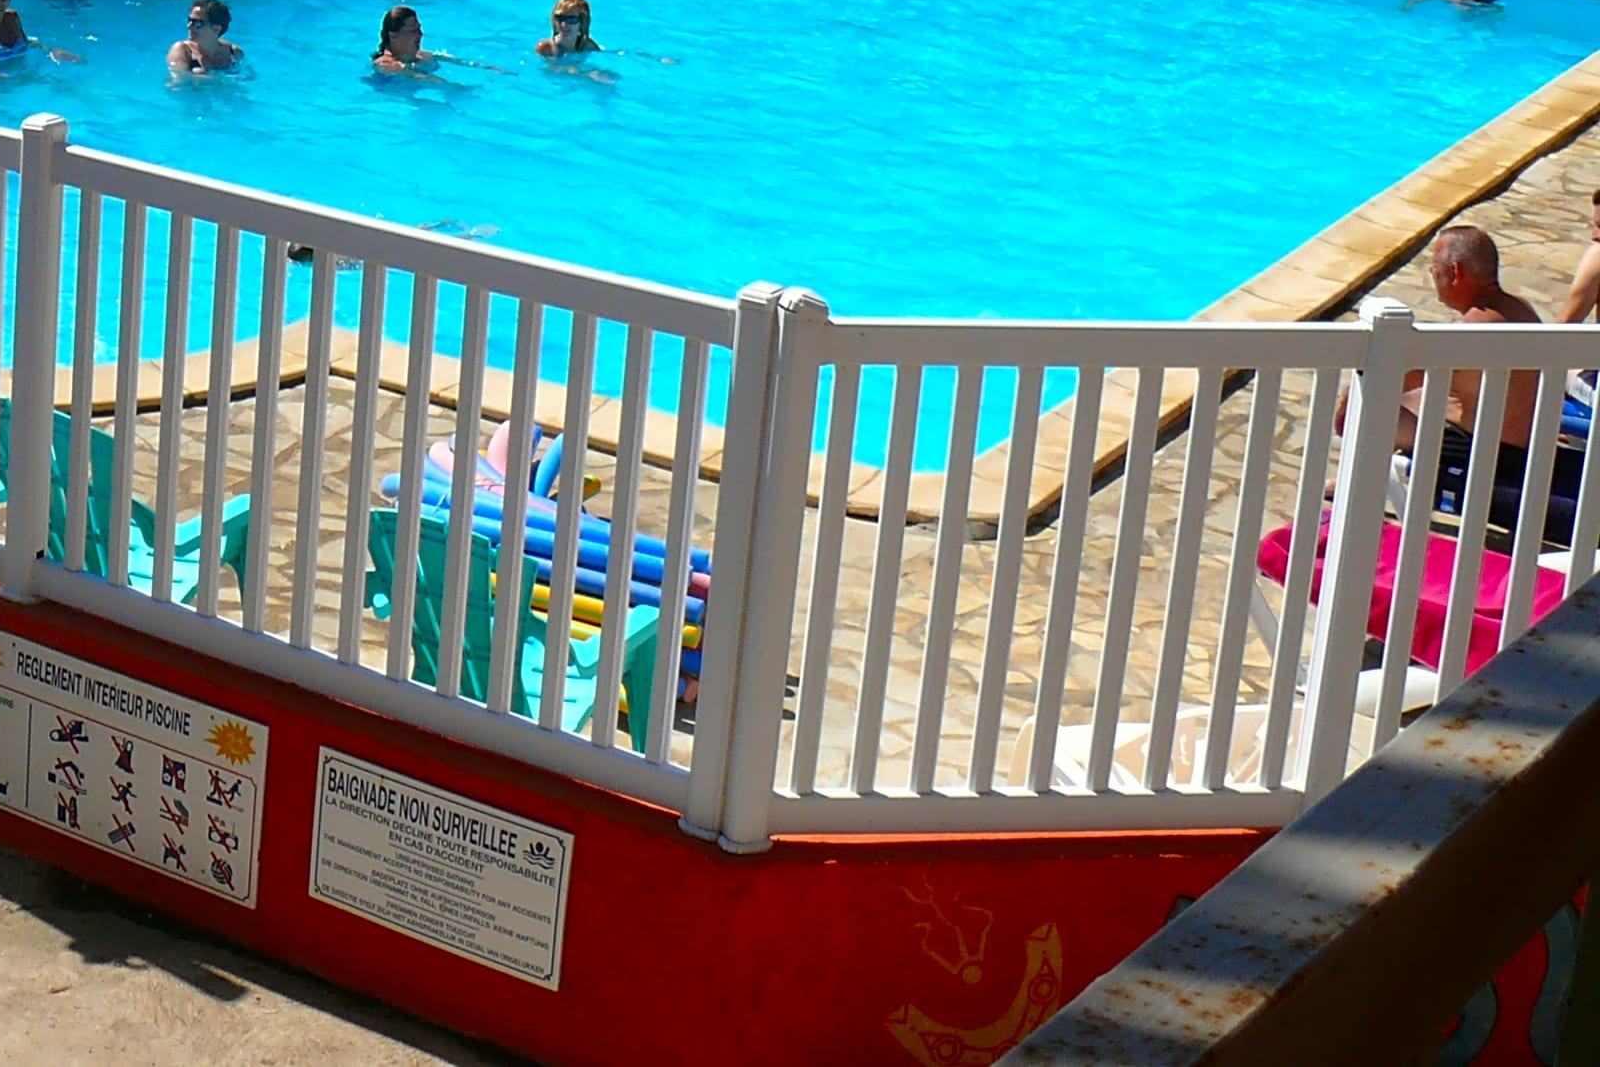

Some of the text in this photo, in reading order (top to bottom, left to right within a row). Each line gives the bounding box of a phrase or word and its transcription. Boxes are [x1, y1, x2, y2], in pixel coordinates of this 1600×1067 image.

[17, 651, 82, 697] REGLEMENT
[145, 698, 191, 737] PISCINE
[325, 795, 556, 888] LA DIRECTION DECLINE TOUTE RESPONSABILITE
[328, 767, 518, 859] BAIGNADE NON SURVEILLEE
[389, 831, 484, 874] EN CAS D'ACCIDENT
[324, 833, 334, 843] THE
[337, 838, 381, 861] MANAGEMENT
[383, 856, 412, 873] ACCEPTS
[482, 893, 496, 904] FOR
[512, 904, 551, 925] ACCIDENTS
